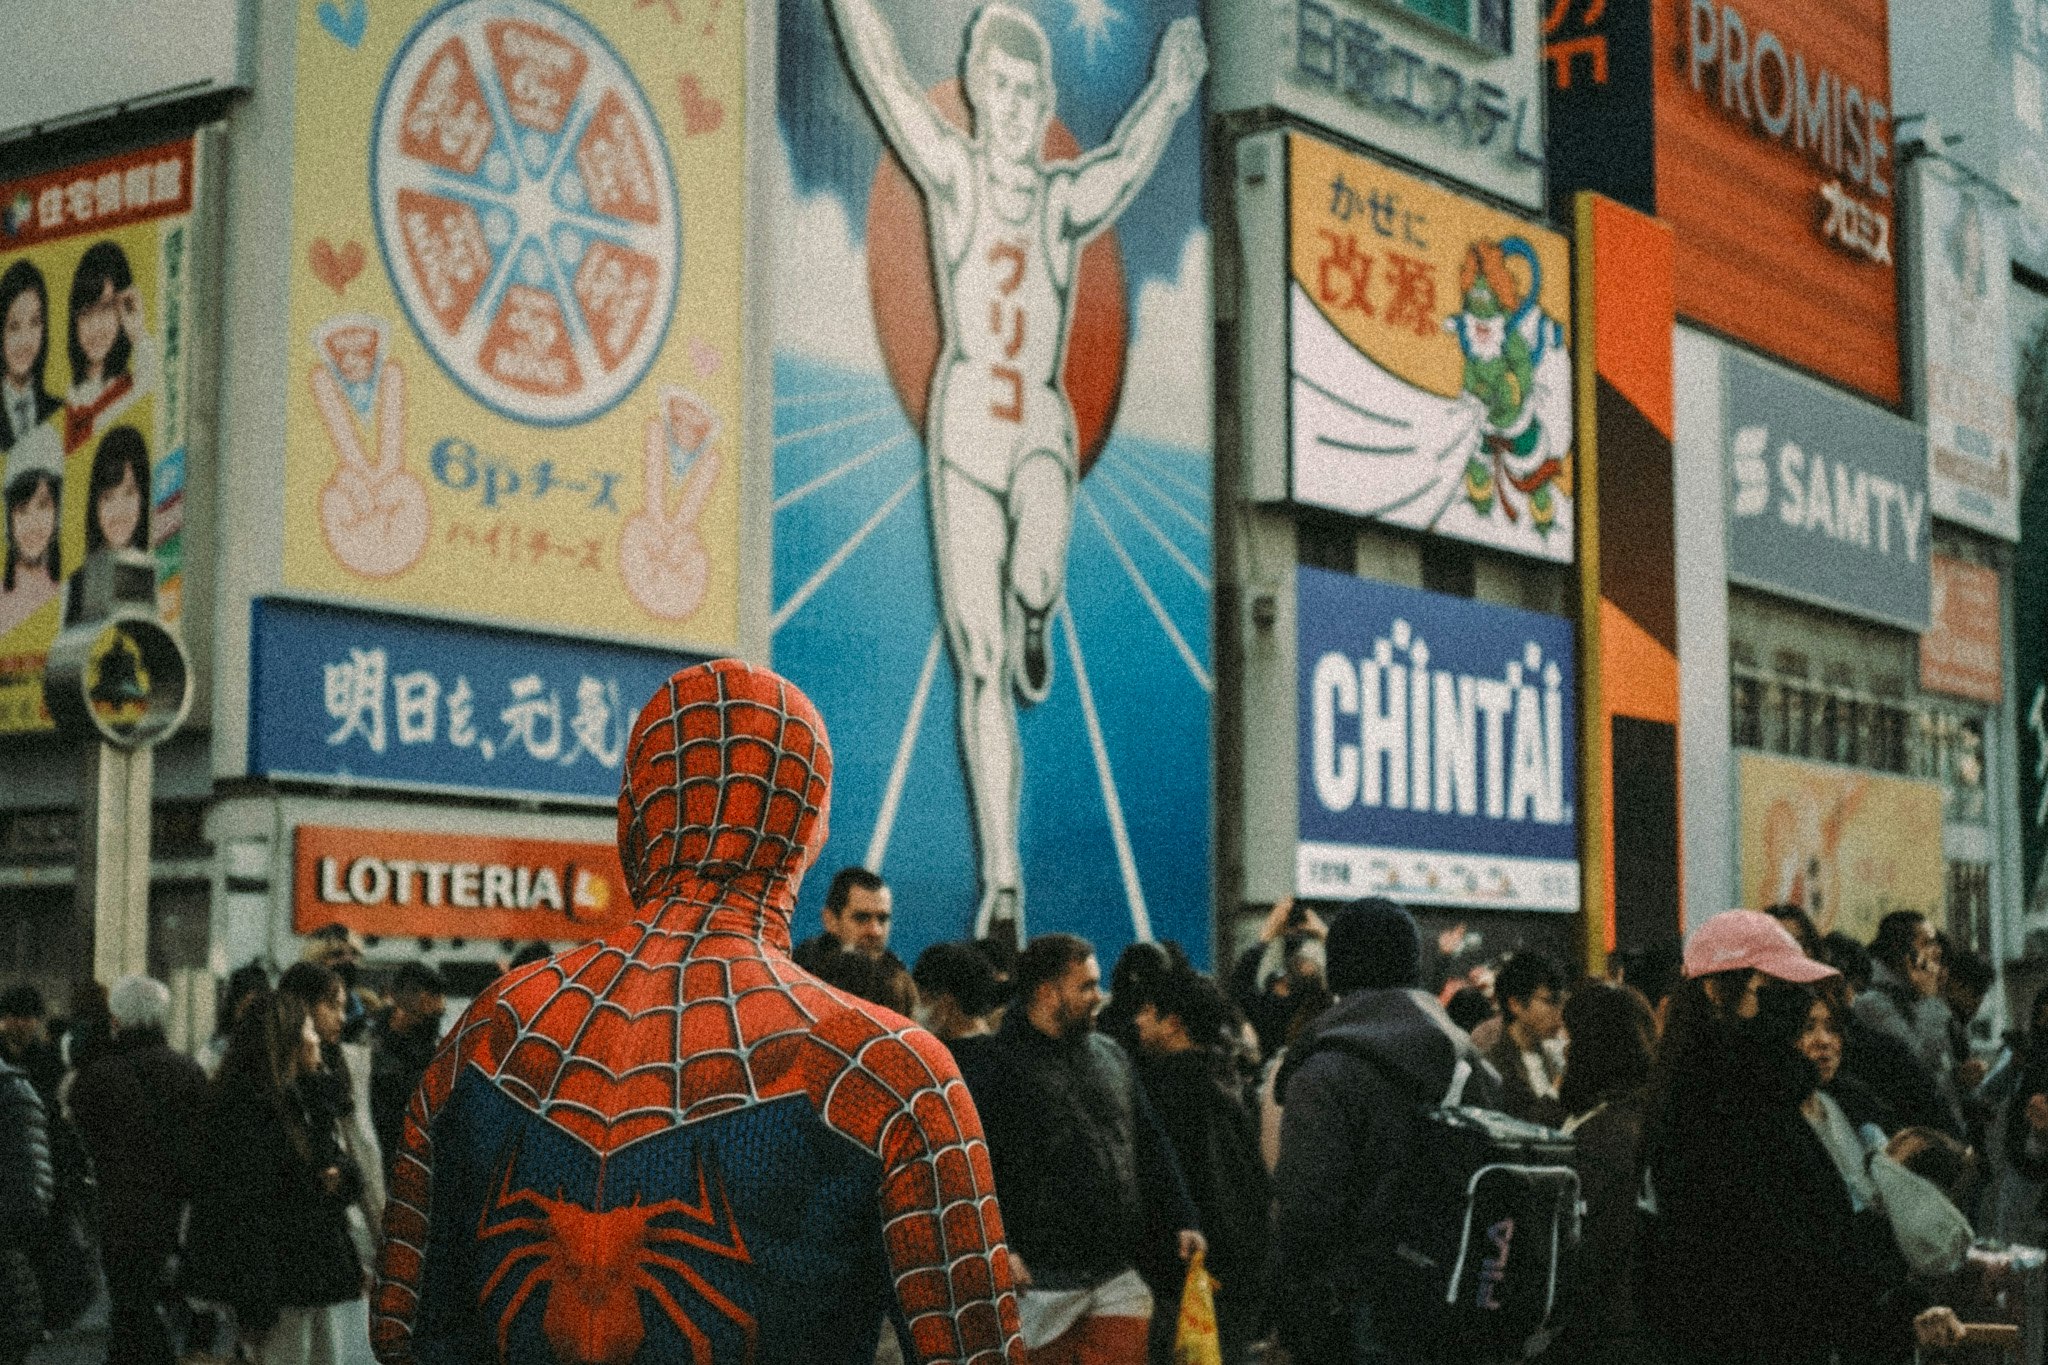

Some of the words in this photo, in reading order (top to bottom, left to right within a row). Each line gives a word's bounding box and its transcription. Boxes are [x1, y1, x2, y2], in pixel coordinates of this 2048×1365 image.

[1690, 0, 1890, 195] PROMISE
[1330, 172, 1428, 249] かぜに
[1317, 227, 1437, 337] 改源
[1779, 440, 1924, 563] SAMTY
[323, 647, 638, 768] 明日も、元気
[1312, 617, 1563, 824] CHINTAI
[319, 855, 563, 909] LOTTERIA
[1477, 1217, 1514, 1310] FILA
